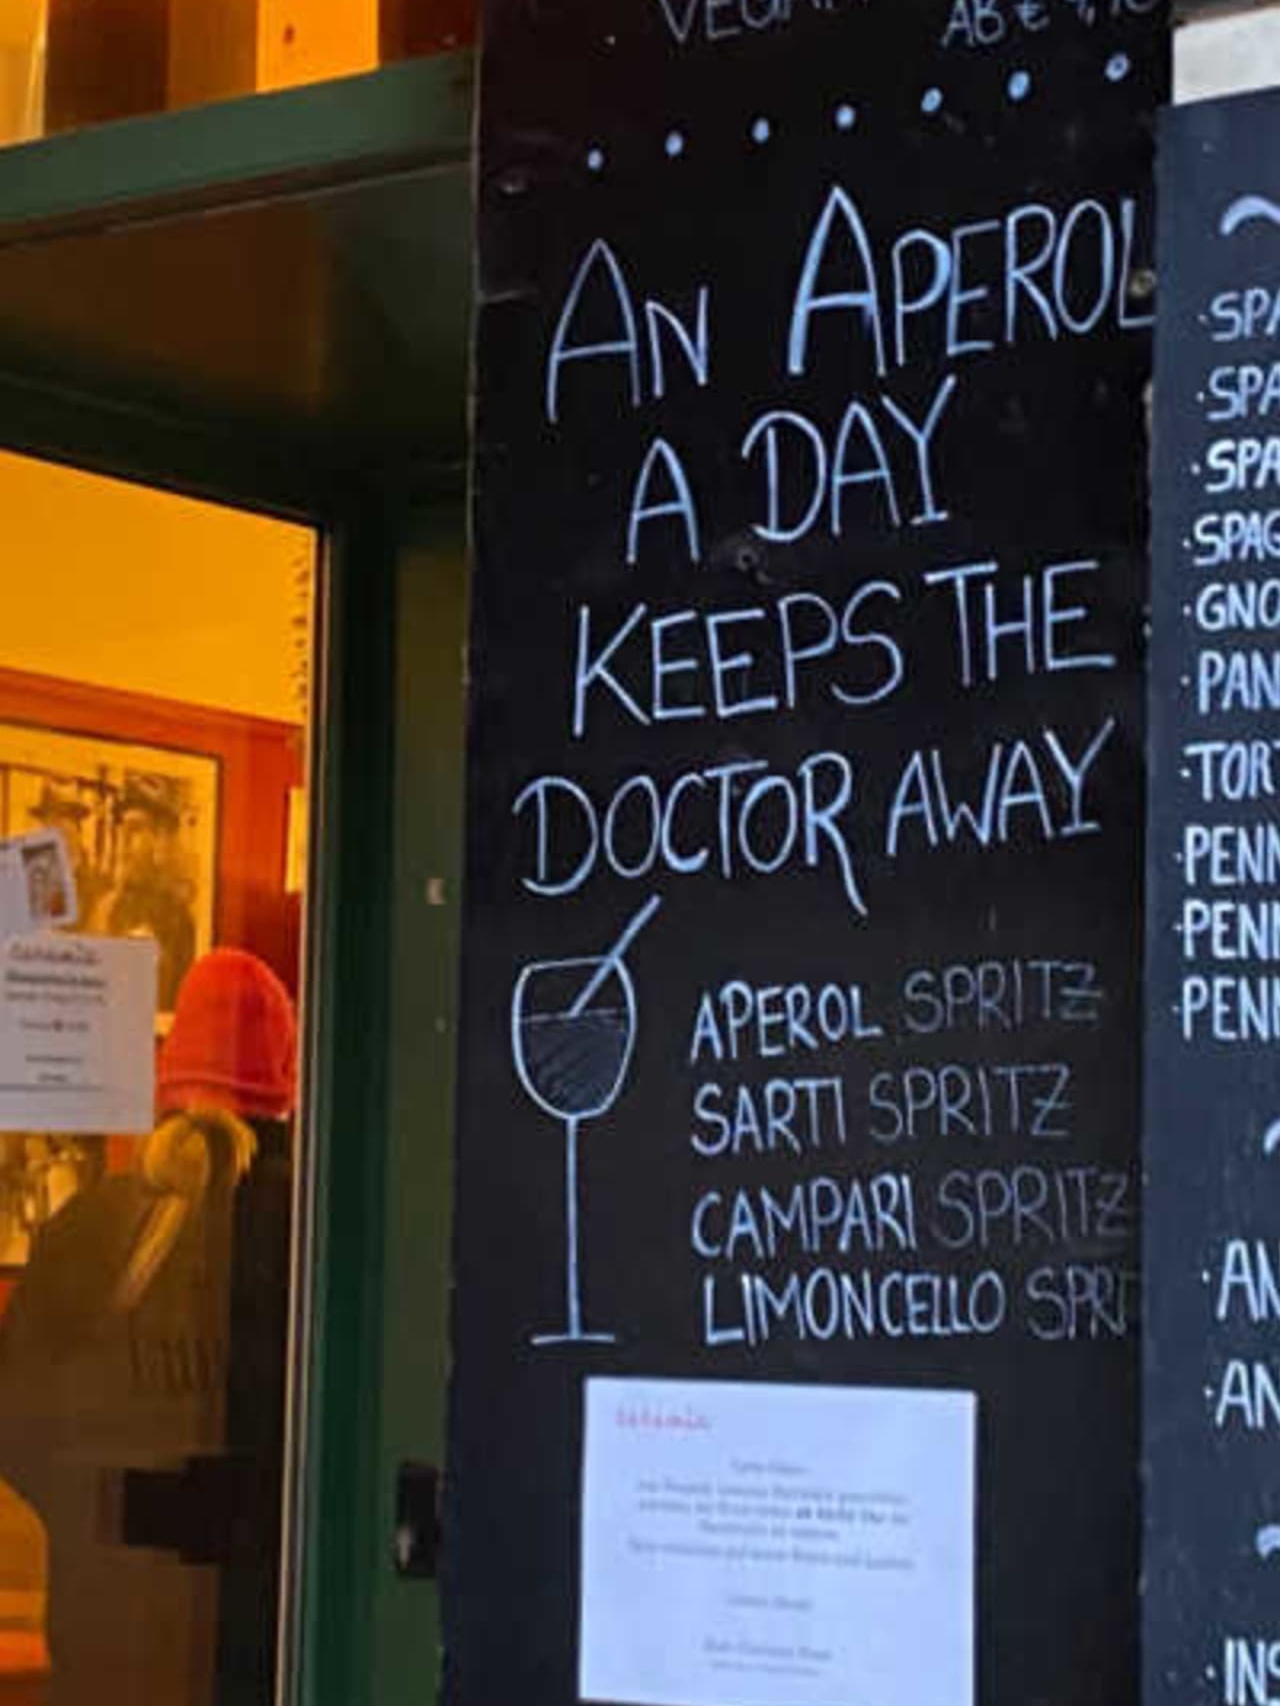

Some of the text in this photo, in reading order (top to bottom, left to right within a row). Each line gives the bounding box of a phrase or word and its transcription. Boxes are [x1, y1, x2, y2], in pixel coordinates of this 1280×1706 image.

[546, 185, 1156, 423] AN APEROL
[626, 373, 956, 564] A DAY
[573, 560, 1117, 736] KEEPS THE
[512, 717, 1116, 917] DOCTOR AWAY
[689, 958, 1104, 1062] APEROL SPRITZ
[689, 1062, 1073, 1156] SARTI SPRITZ
[689, 1166, 1133, 1261] CAMPARI SPRITZ
[704, 1266, 1008, 1346] LIMONCELLO
